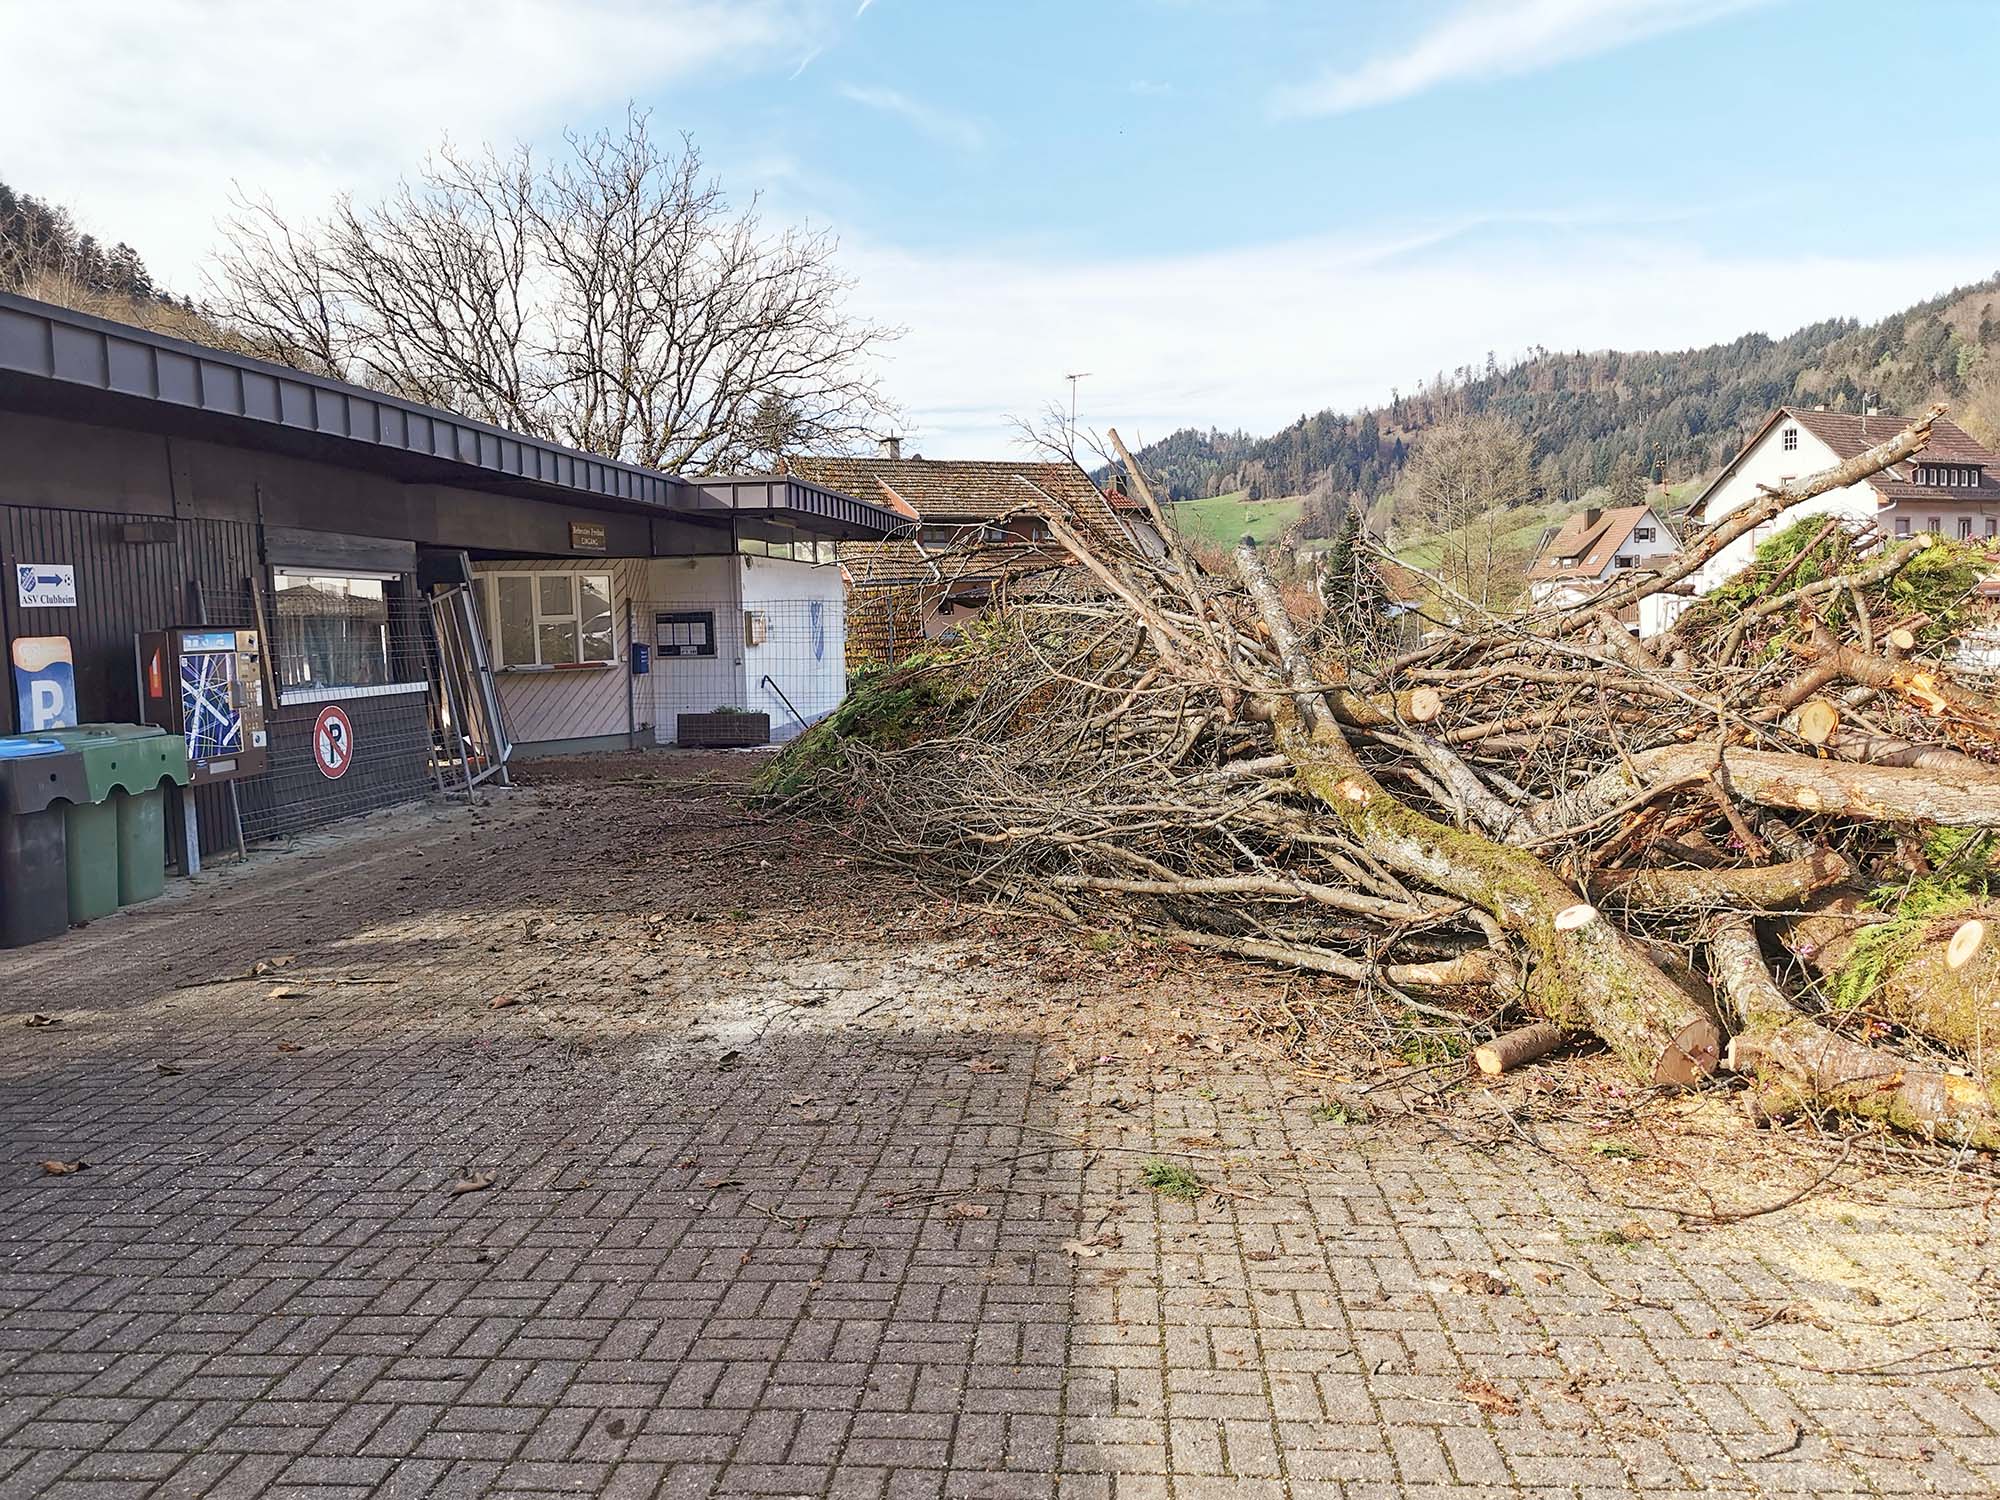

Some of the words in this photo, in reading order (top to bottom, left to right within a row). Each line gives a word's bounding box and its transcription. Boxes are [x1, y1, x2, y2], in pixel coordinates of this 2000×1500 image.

[22, 595, 38, 604] ASV
[40, 594, 75, 604] Clubheim
[31, 680, 64, 731] P
